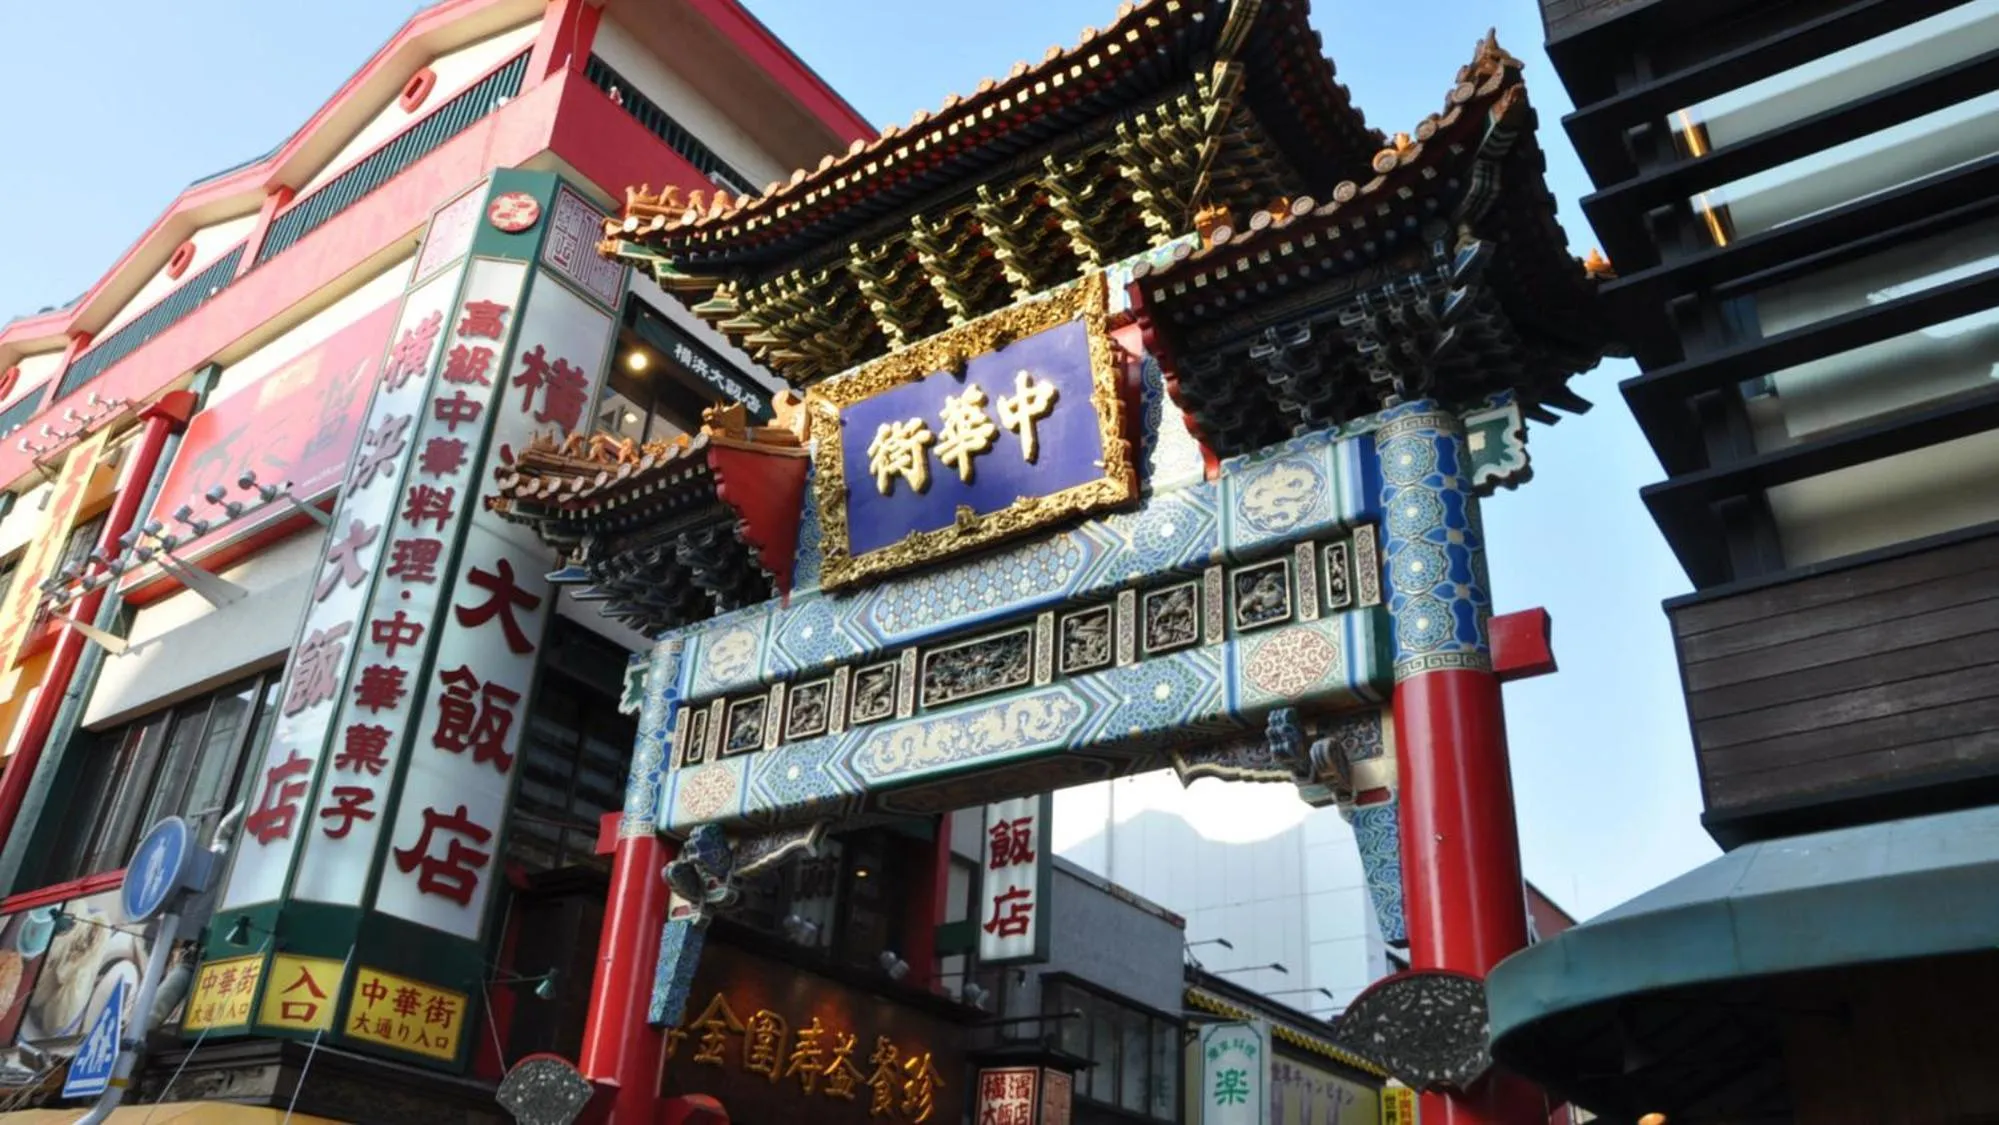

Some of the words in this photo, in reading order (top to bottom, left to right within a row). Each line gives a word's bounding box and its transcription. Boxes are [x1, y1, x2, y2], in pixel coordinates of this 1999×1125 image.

[867, 370, 1058, 495] 中華街
[393, 344, 589, 907] 横大飯店
[983, 816, 1035, 938] 飯店
[202, 960, 260, 998] 中華街
[281, 966, 326, 1023] 入口
[361, 978, 457, 1029] 中華街
[352, 1012, 450, 1049] 大通り入口
